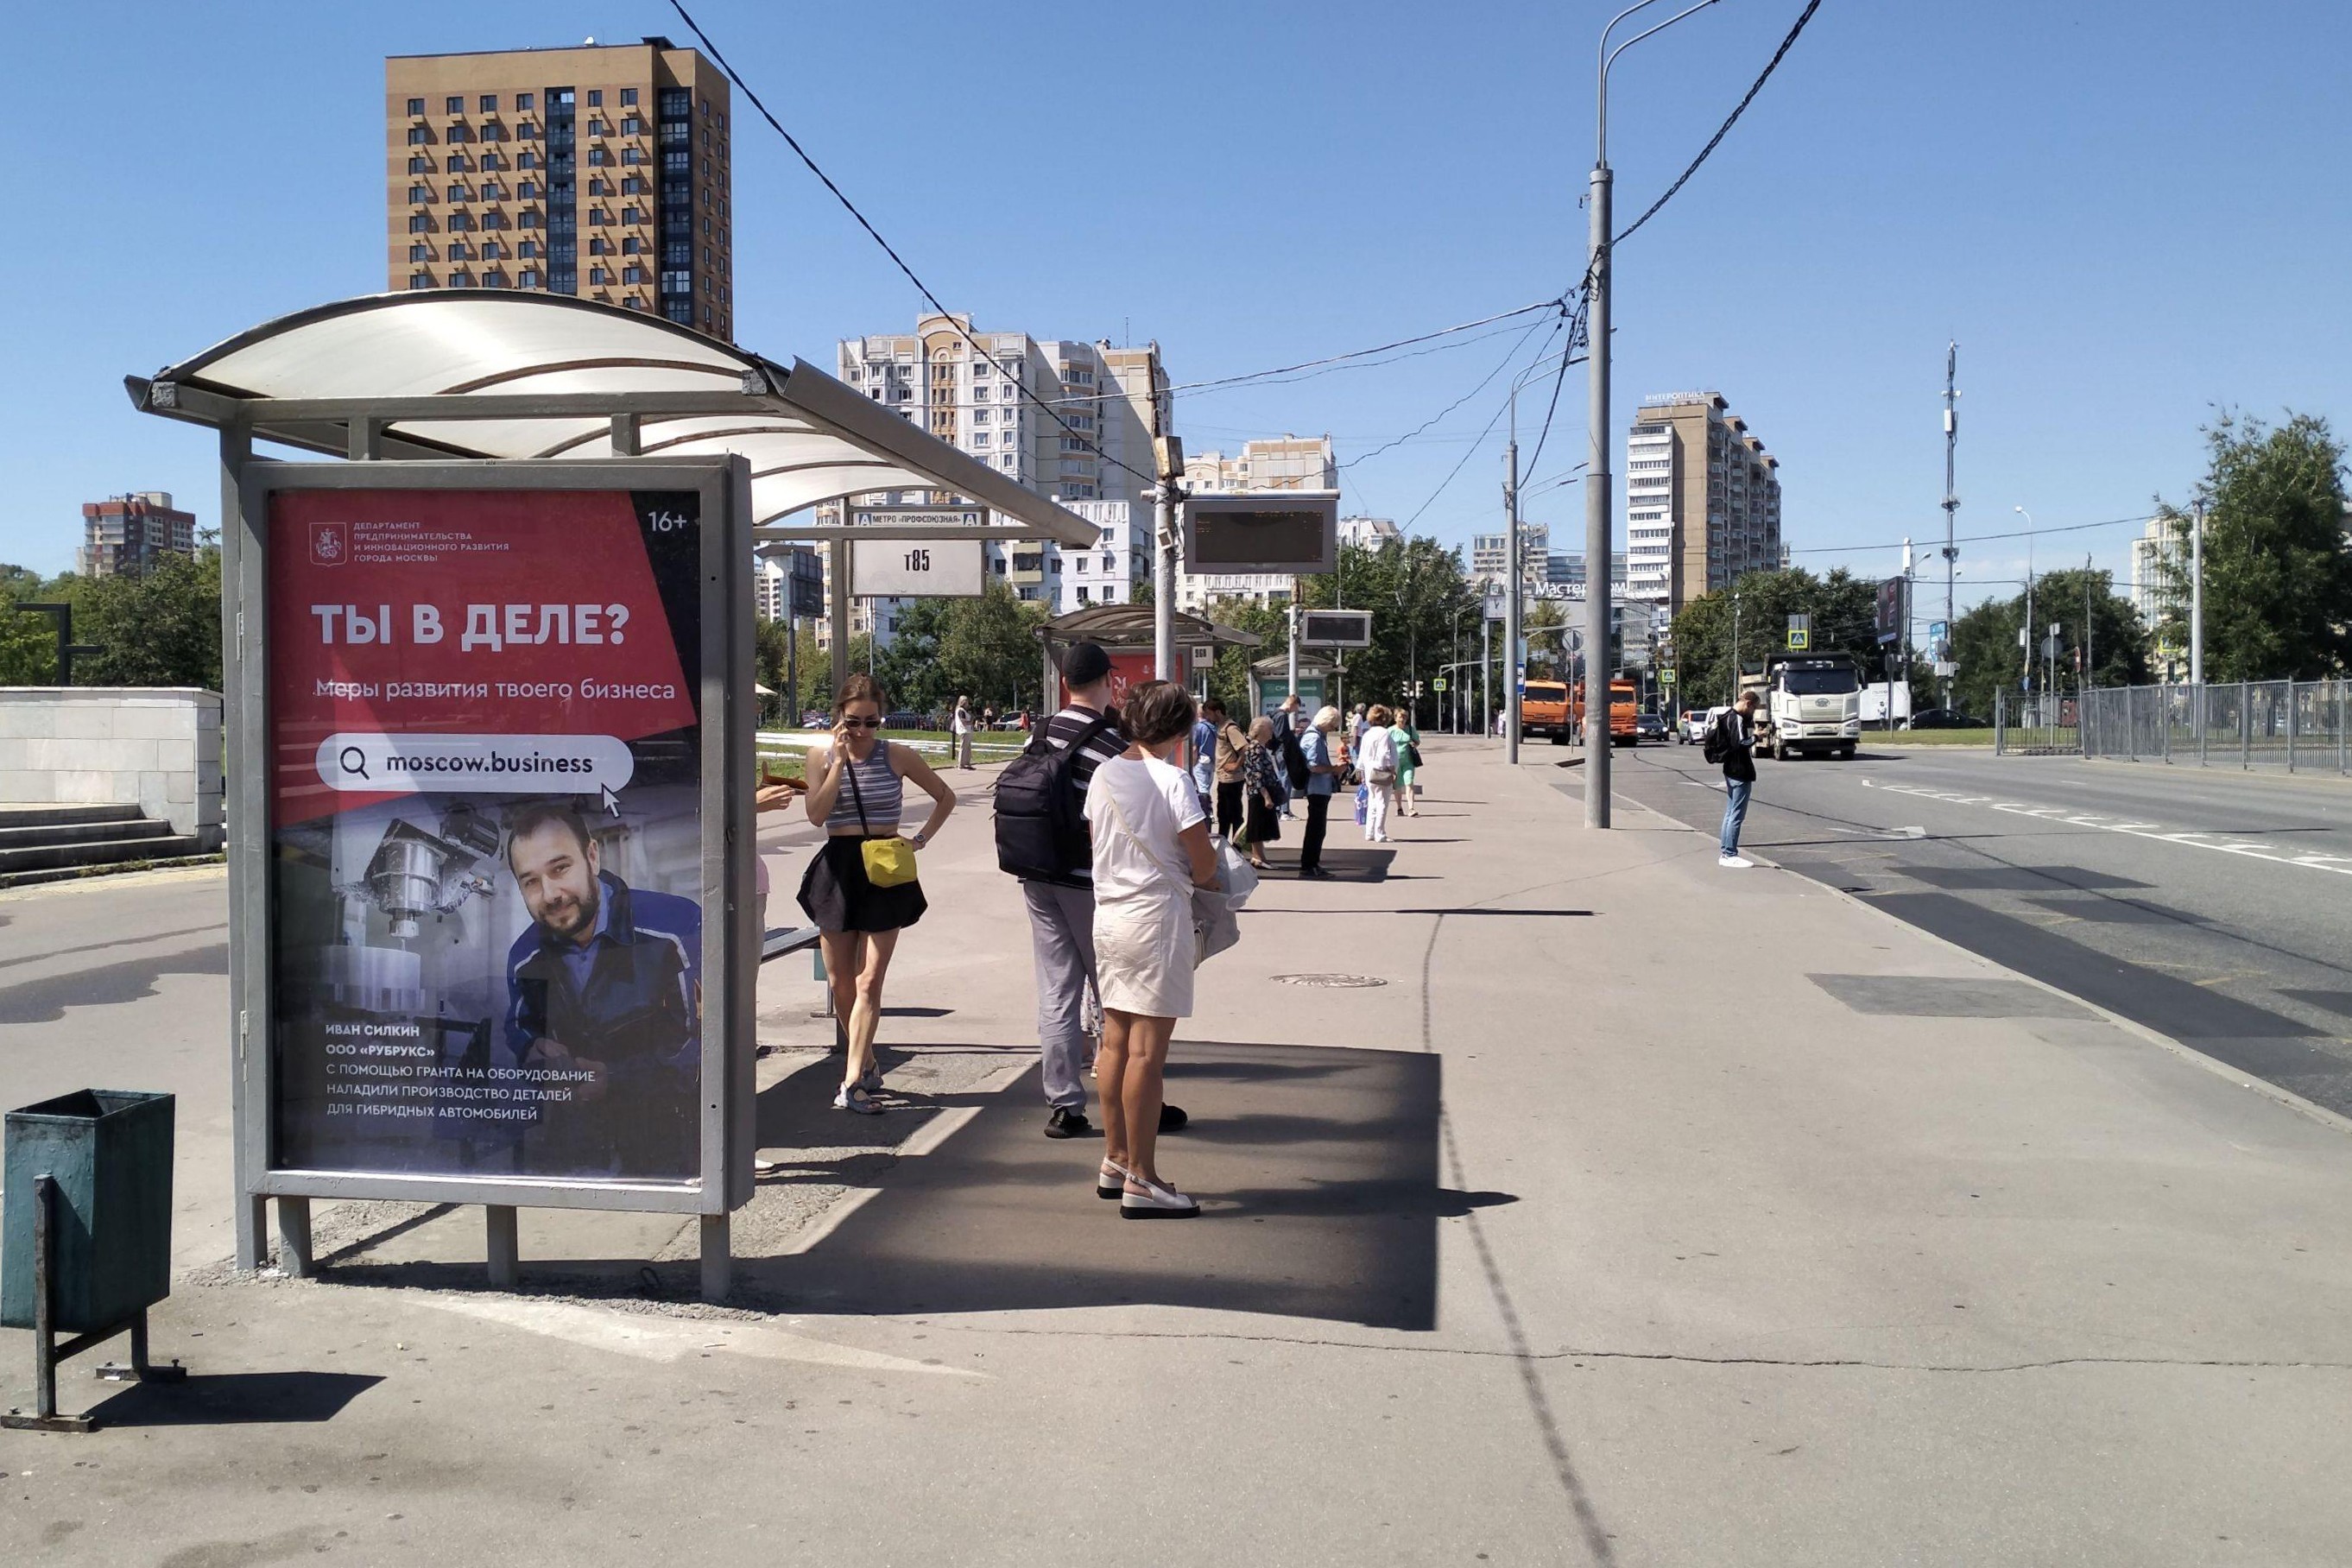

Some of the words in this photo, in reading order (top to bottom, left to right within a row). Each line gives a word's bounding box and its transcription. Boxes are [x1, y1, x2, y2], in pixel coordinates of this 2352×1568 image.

[353, 522, 420, 530] ДЕПАРТАМЕНТ
[648, 510, 687, 533] 16+
[354, 533, 472, 541] ПРЕДПРИНИМАТЕЛЬСТВА
[364, 543, 458, 552] ИННОВАЦИОННОГО
[354, 554, 392, 563] ГОРОДА
[1534, 581, 1626, 598] Мастерм
[311, 604, 391, 644] ТЫ
[414, 604, 444, 644] В
[461, 603, 629, 652] ДЕЛЕ?
[316, 679, 379, 702] Меры
[386, 683, 488, 702] развития
[496, 683, 572, 699] твоего
[580, 678, 676, 700] бизнеса
[386, 751, 593, 774] moscow.business
[326, 1024, 360, 1035] ИВАН
[364, 1025, 420, 1036] СИЛКИН
[326, 1044, 357, 1055] ООО
[360, 1046, 435, 1058] «РУБРУКС»
[326, 1064, 336, 1075] С
[339, 1065, 413, 1078] ПОМОЩЬЮ
[416, 1066, 463, 1078] ГРАНТА
[466, 1068, 484, 1078] НА
[487, 1069, 596, 1082] ОБОРУДОВАНИЕ
[326, 1084, 398, 1097] НАЛАДИЛИ
[401, 1085, 509, 1100] ПРОИЗВОДСТВО
[513, 1087, 572, 1102] ДЕТАЛЕЙ
[326, 1103, 352, 1116] ДЛЯ
[356, 1105, 434, 1118] ГИБРИДНЫХ
[438, 1106, 537, 1121] АВТОМОБИЛЕЙ
